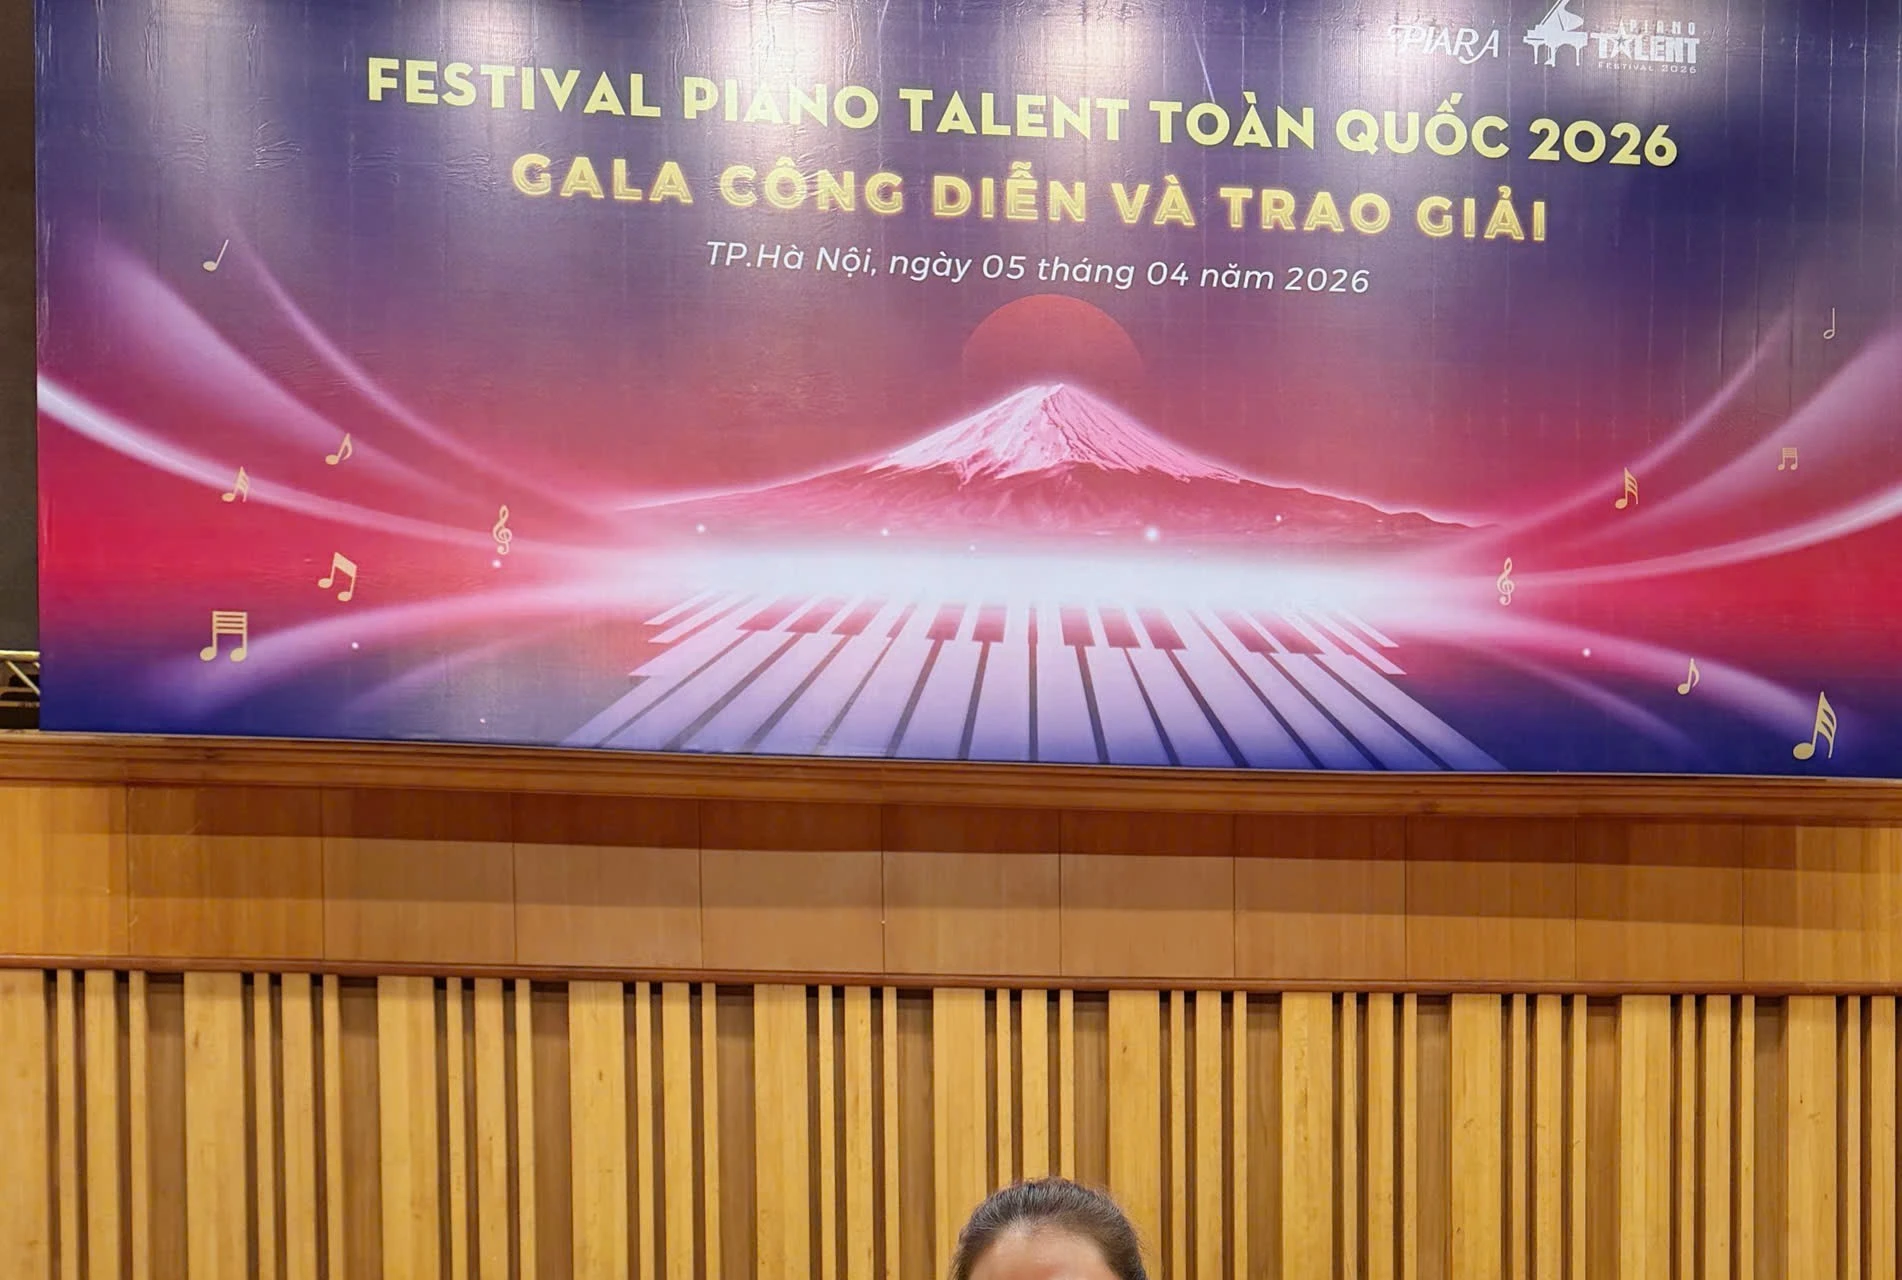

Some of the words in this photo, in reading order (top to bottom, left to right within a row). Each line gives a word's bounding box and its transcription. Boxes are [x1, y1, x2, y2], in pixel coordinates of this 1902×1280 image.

[1388, 24, 1500, 65] PIARA
[1590, 19, 1700, 64] TALENT
[1630, 20, 1696, 35] PIANO
[1598, 62, 1655, 72] FESTIVAL
[1661, 64, 1697, 74] 2026
[366, 57, 661, 118] FESTIVAL
[683, 76, 879, 130] PIANO
[900, 88, 1129, 141] TALENT
[1150, 92, 1315, 149] TOÀN
[1336, 92, 1510, 160] QUỐC
[1528, 119, 1678, 167] 2026
[511, 153, 693, 205] GALA
[719, 157, 903, 215] CÔNG
[932, 161, 1103, 222] DIỄN
[1110, 174, 1195, 228] VÀ
[1220, 187, 1392, 236] TRAO
[1416, 186, 1547, 242] GIẢI
[706, 241, 804, 270] TP.Hà
[815, 247, 878, 279] Nội,
[888, 251, 972, 283] ngày
[981, 254, 1027, 280] 05
[1037, 256, 1136, 290] tháng
[1146, 261, 1190, 287] 04
[1199, 263, 1275, 290] năm
[1284, 266, 1371, 293] 2026
